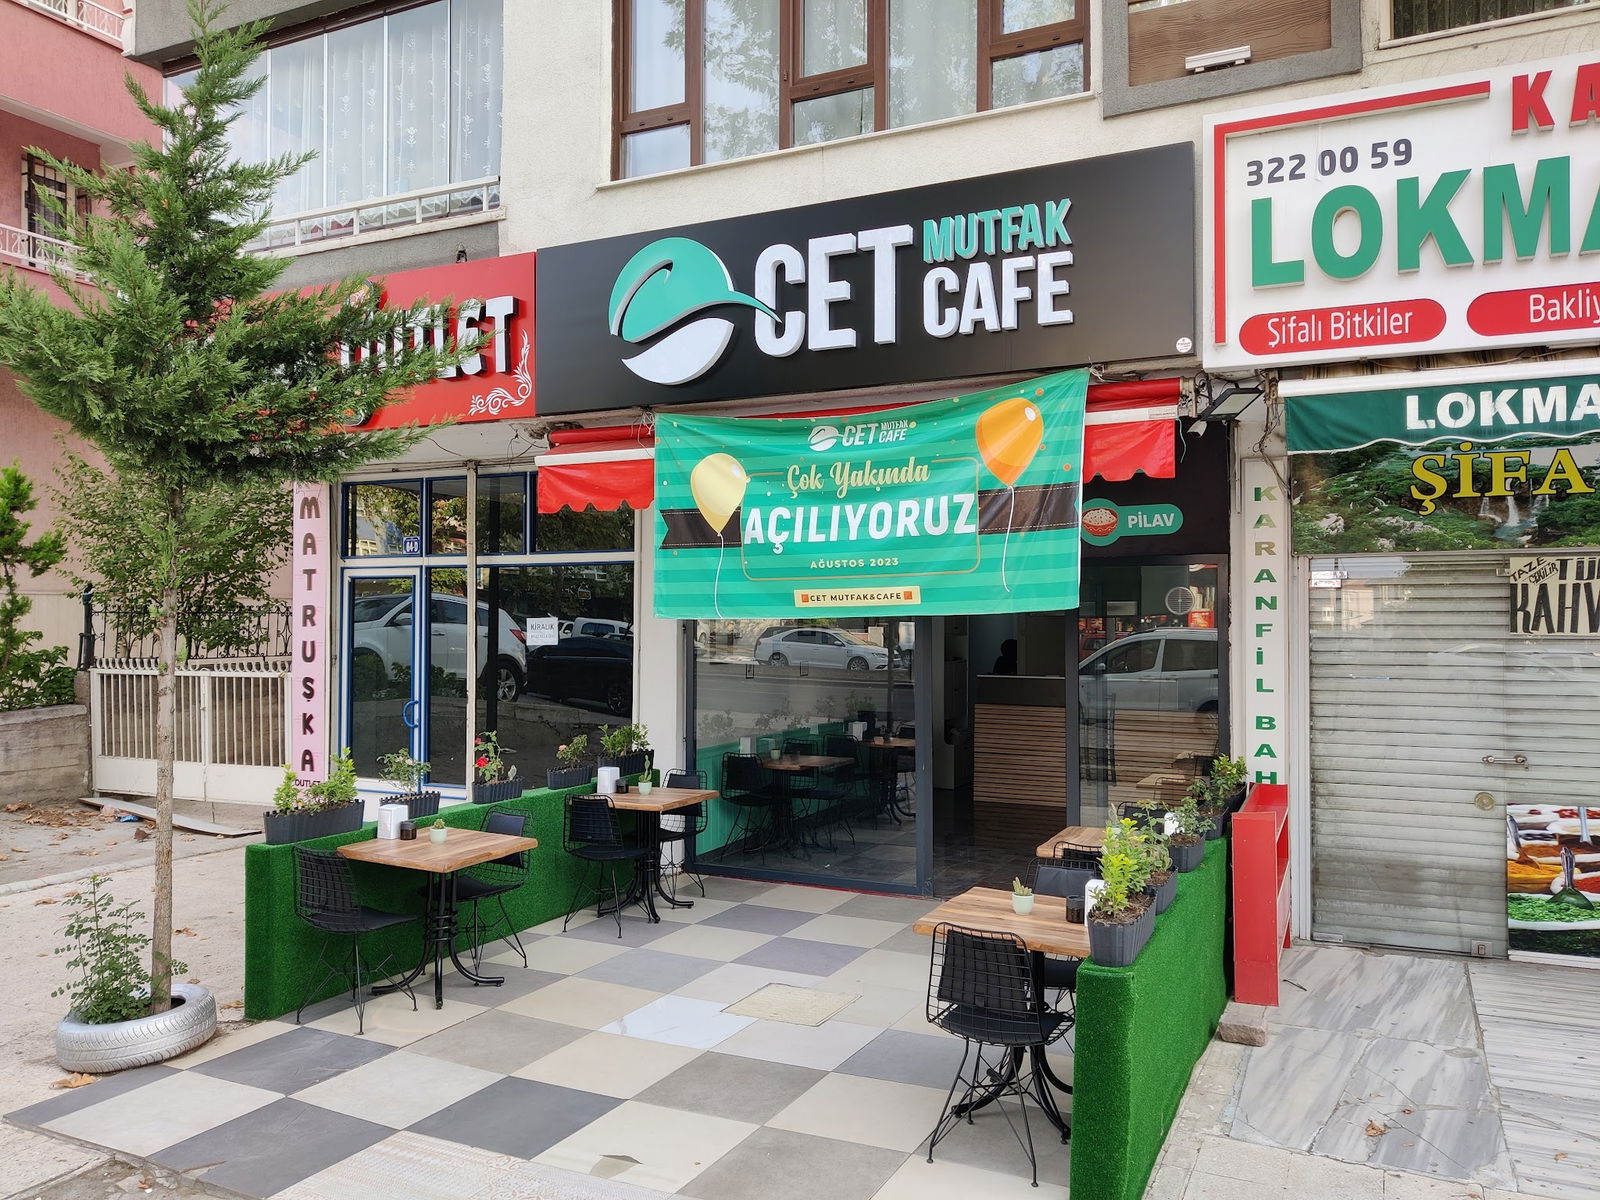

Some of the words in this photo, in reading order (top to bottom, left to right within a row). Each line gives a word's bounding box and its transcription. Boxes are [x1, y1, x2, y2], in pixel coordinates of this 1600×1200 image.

[1246, 153, 1306, 187] 322
[1318, 146, 1358, 177] 00
[1370, 138, 1413, 169] 59
[922, 198, 1074, 264] MUTFAK
[754, 223, 914, 358] CET
[922, 250, 1075, 339] CAFE
[1267, 312, 1323, 348] Şifalı
[1330, 306, 1413, 341] Bitkiler
[880, 420, 909, 431] MUTFAK
[1405, 383, 1600, 430] LOKMA
[841, 423, 879, 447] CET
[878, 428, 908, 443] CAFE
[787, 464, 825, 498] Çok
[829, 456, 930, 499] Yakında
[1409, 441, 1596, 517] ŞİFA
[744, 493, 978, 554] AÇILIYORUZ
[1127, 511, 1176, 529] PİLAV
[810, 557, 865, 569] AĞUSTOS
[869, 556, 899, 567] 2023
[1511, 556, 1546, 582] TAZE
[1556, 557, 1600, 581] TÜ
[810, 594, 827, 602] CET
[830, 592, 902, 602] MUTFAK&CAFE
[1253, 486, 1278, 693] KARANFİL
[299, 496, 321, 773] MATRUŞKA
